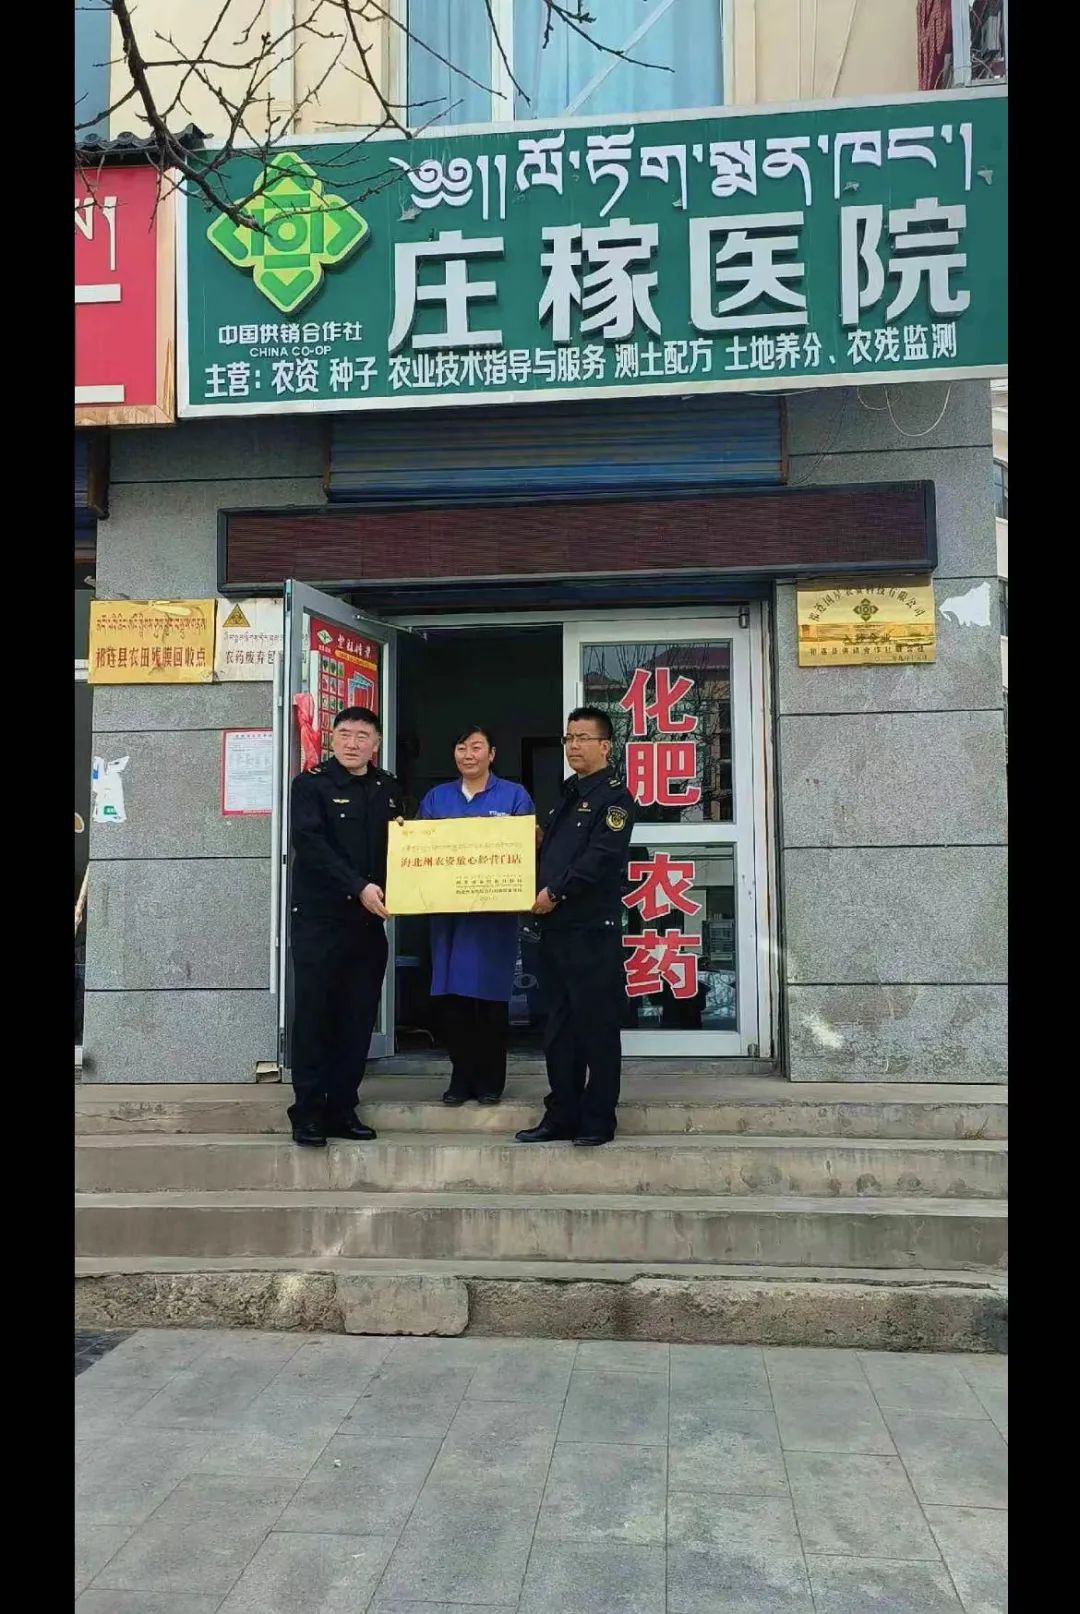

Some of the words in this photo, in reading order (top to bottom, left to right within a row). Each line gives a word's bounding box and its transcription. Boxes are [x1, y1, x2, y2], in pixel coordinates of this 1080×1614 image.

[388, 197, 971, 353] 庄稼医院
[218, 321, 363, 345] 中国供销合作社
[249, 347, 289, 358] CHINA
[291, 345, 332, 357] CO-OP
[330, 356, 378, 392] 种子
[388, 343, 606, 389] 农业技术指导与服务
[614, 338, 713, 378] 测土配方
[95, 646, 206, 669] 祁连县农田残膜回收点
[619, 667, 702, 806] 化肥
[621, 852, 702, 998] 农药
